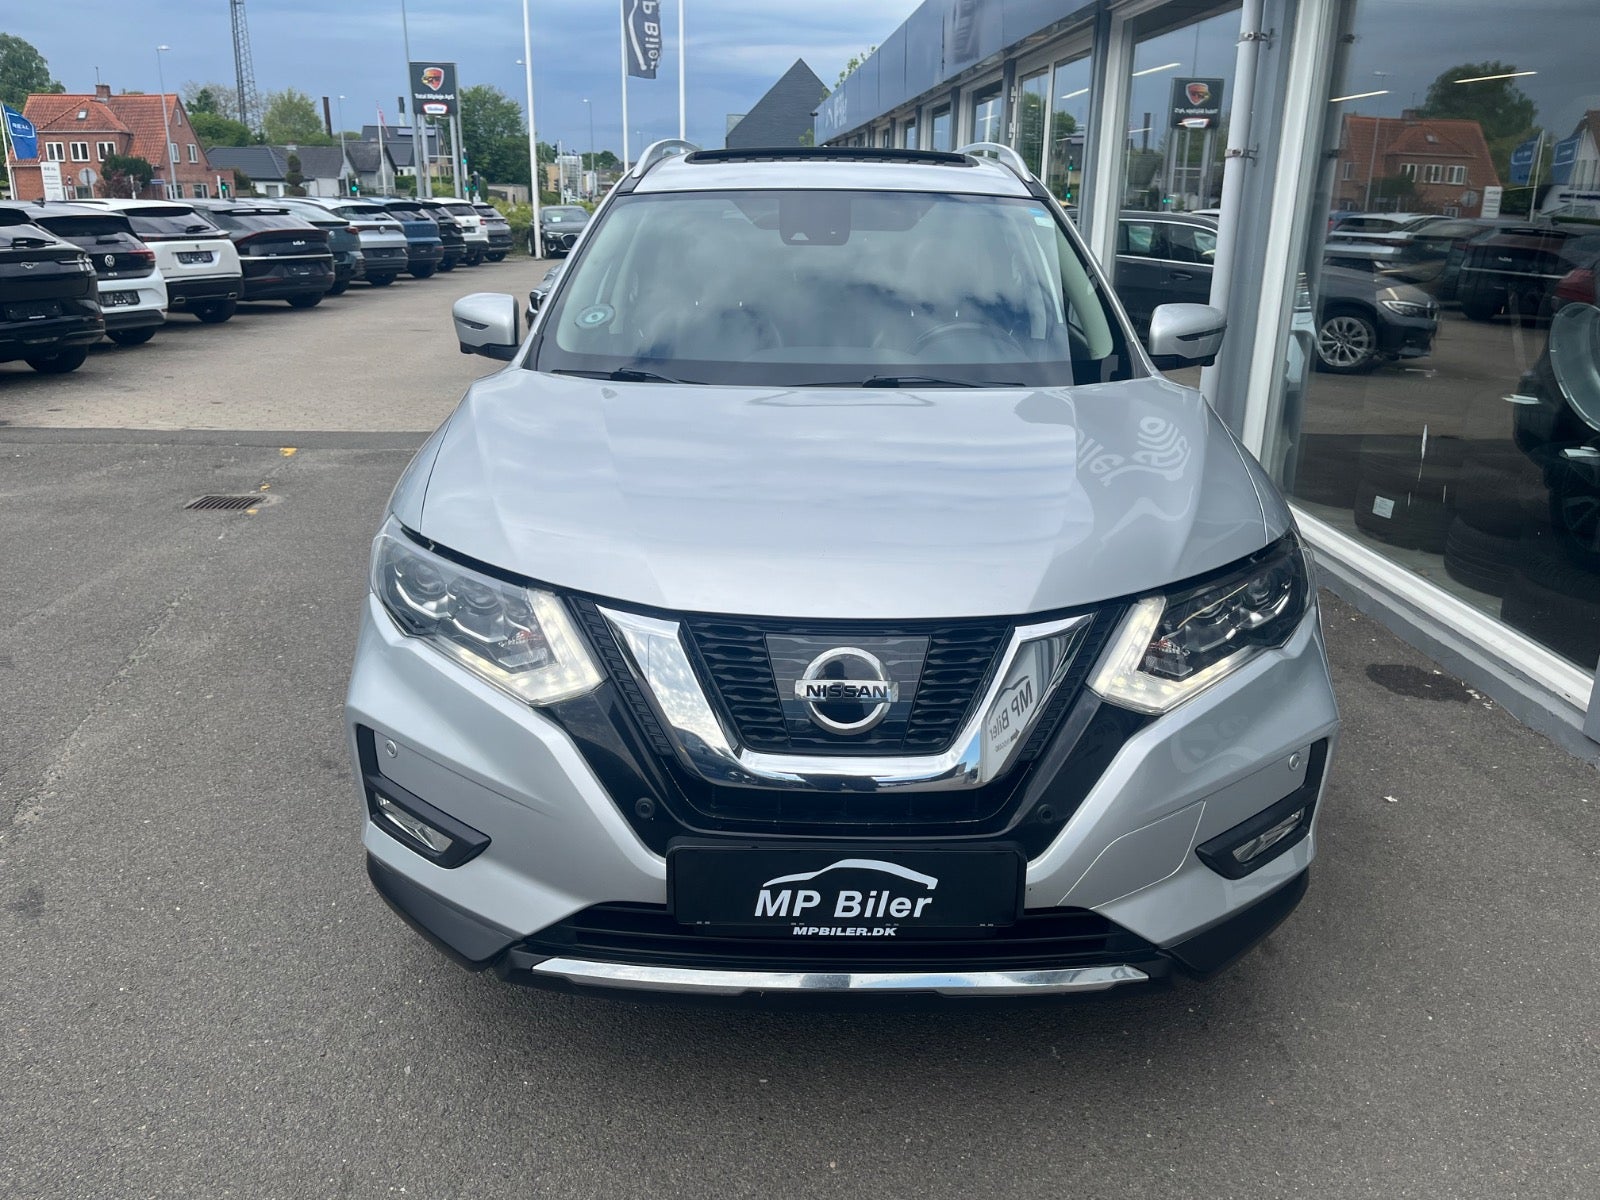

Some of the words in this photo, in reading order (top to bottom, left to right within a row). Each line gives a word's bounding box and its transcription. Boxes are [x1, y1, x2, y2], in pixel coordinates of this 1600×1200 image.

[806, 684, 888, 698] NISSAN
[754, 889, 821, 917] MP
[833, 890, 933, 918] Biler
[792, 926, 898, 937] MPBILER.DK
